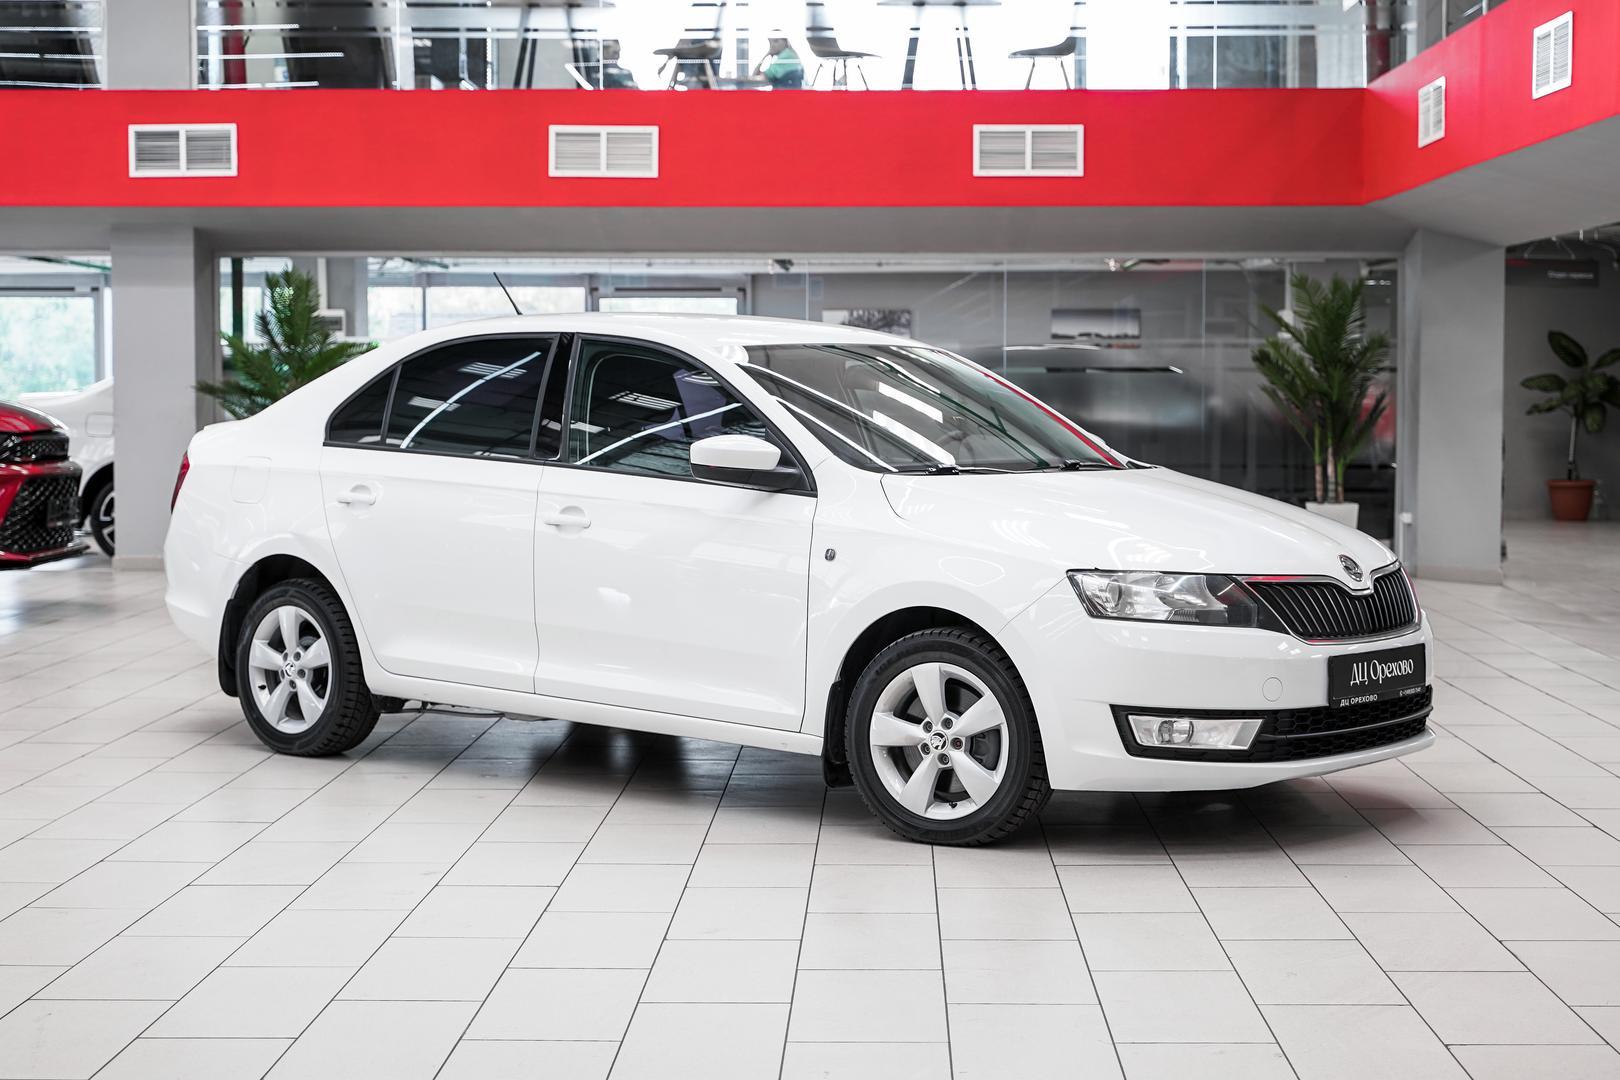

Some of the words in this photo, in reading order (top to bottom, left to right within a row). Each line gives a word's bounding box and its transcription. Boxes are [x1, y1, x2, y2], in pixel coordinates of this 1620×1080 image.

[1350, 662, 1368, 686] ДЦ
[1370, 659, 1414, 684] Орехово
[1350, 694, 1377, 705] ОРЕХОВО
